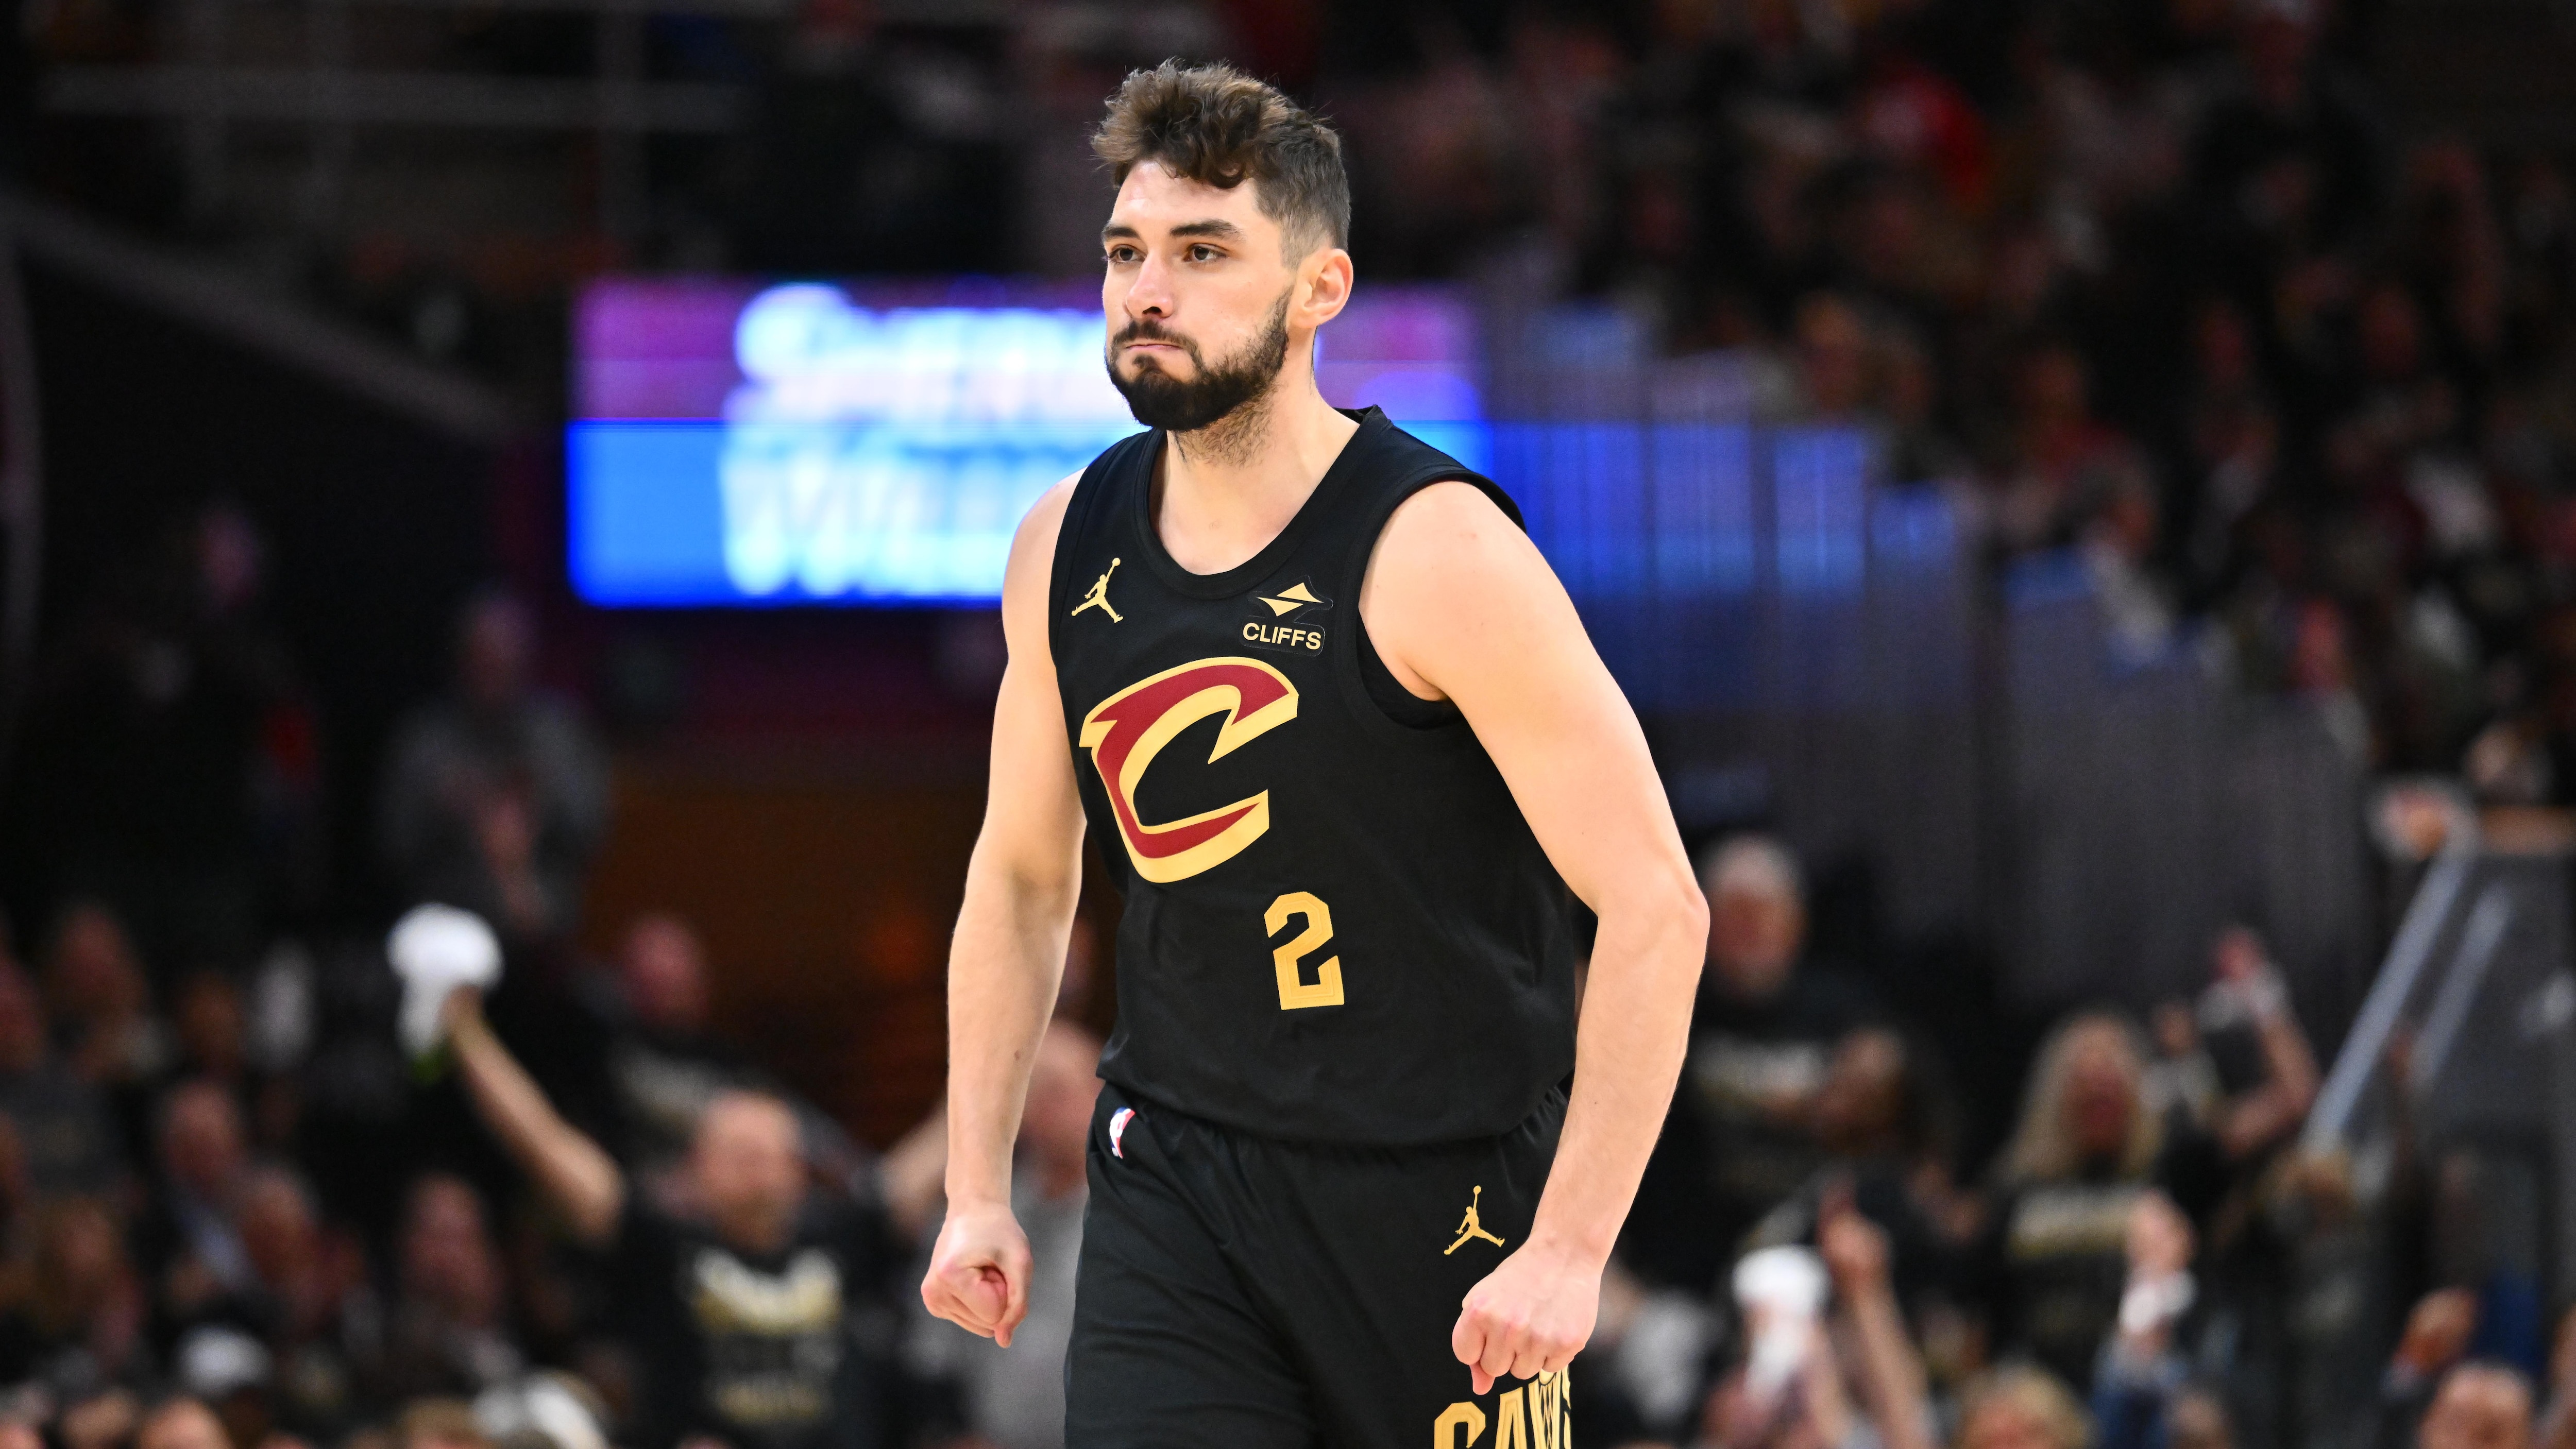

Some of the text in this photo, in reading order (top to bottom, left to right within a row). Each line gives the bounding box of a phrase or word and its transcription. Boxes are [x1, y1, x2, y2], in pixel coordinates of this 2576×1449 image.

[1243, 622, 1321, 650] CLIFFS
[1079, 657, 1299, 883] C
[1264, 891, 1344, 1010] 2
